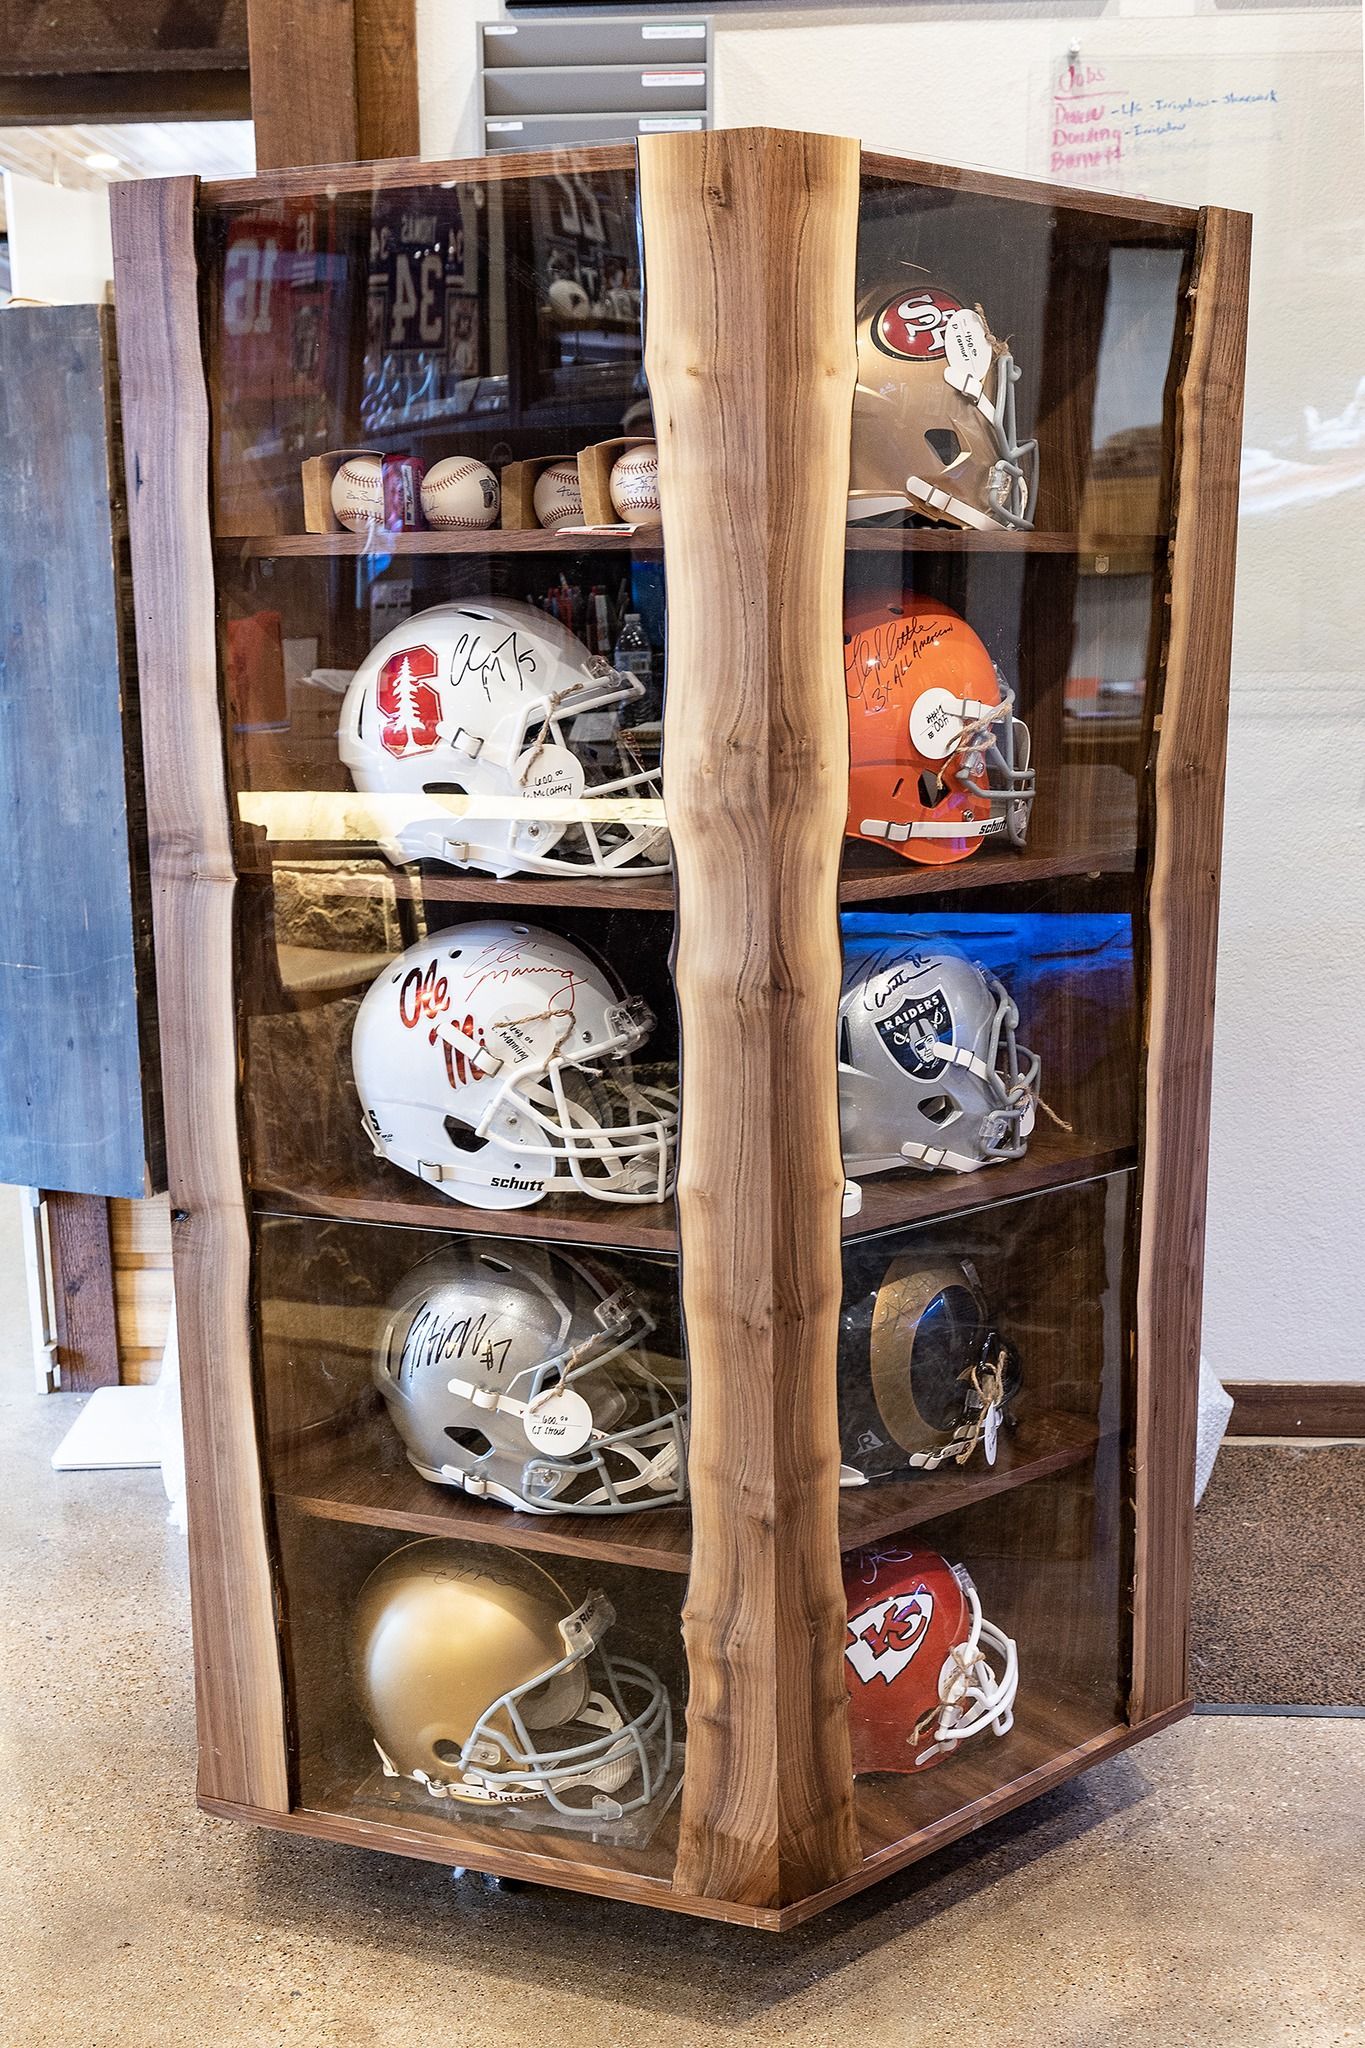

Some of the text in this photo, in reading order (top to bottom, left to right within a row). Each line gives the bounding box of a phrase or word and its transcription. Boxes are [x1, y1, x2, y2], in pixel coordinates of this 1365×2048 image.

[1059, 65, 1105, 92] Jobs
[400, 959, 451, 1029] Ole
[883, 995, 940, 1031] RAIDERS
[499, 1031, 529, 1064] Manning
[491, 1176, 544, 1191] schutt
[860, 1599, 928, 1660] KC
